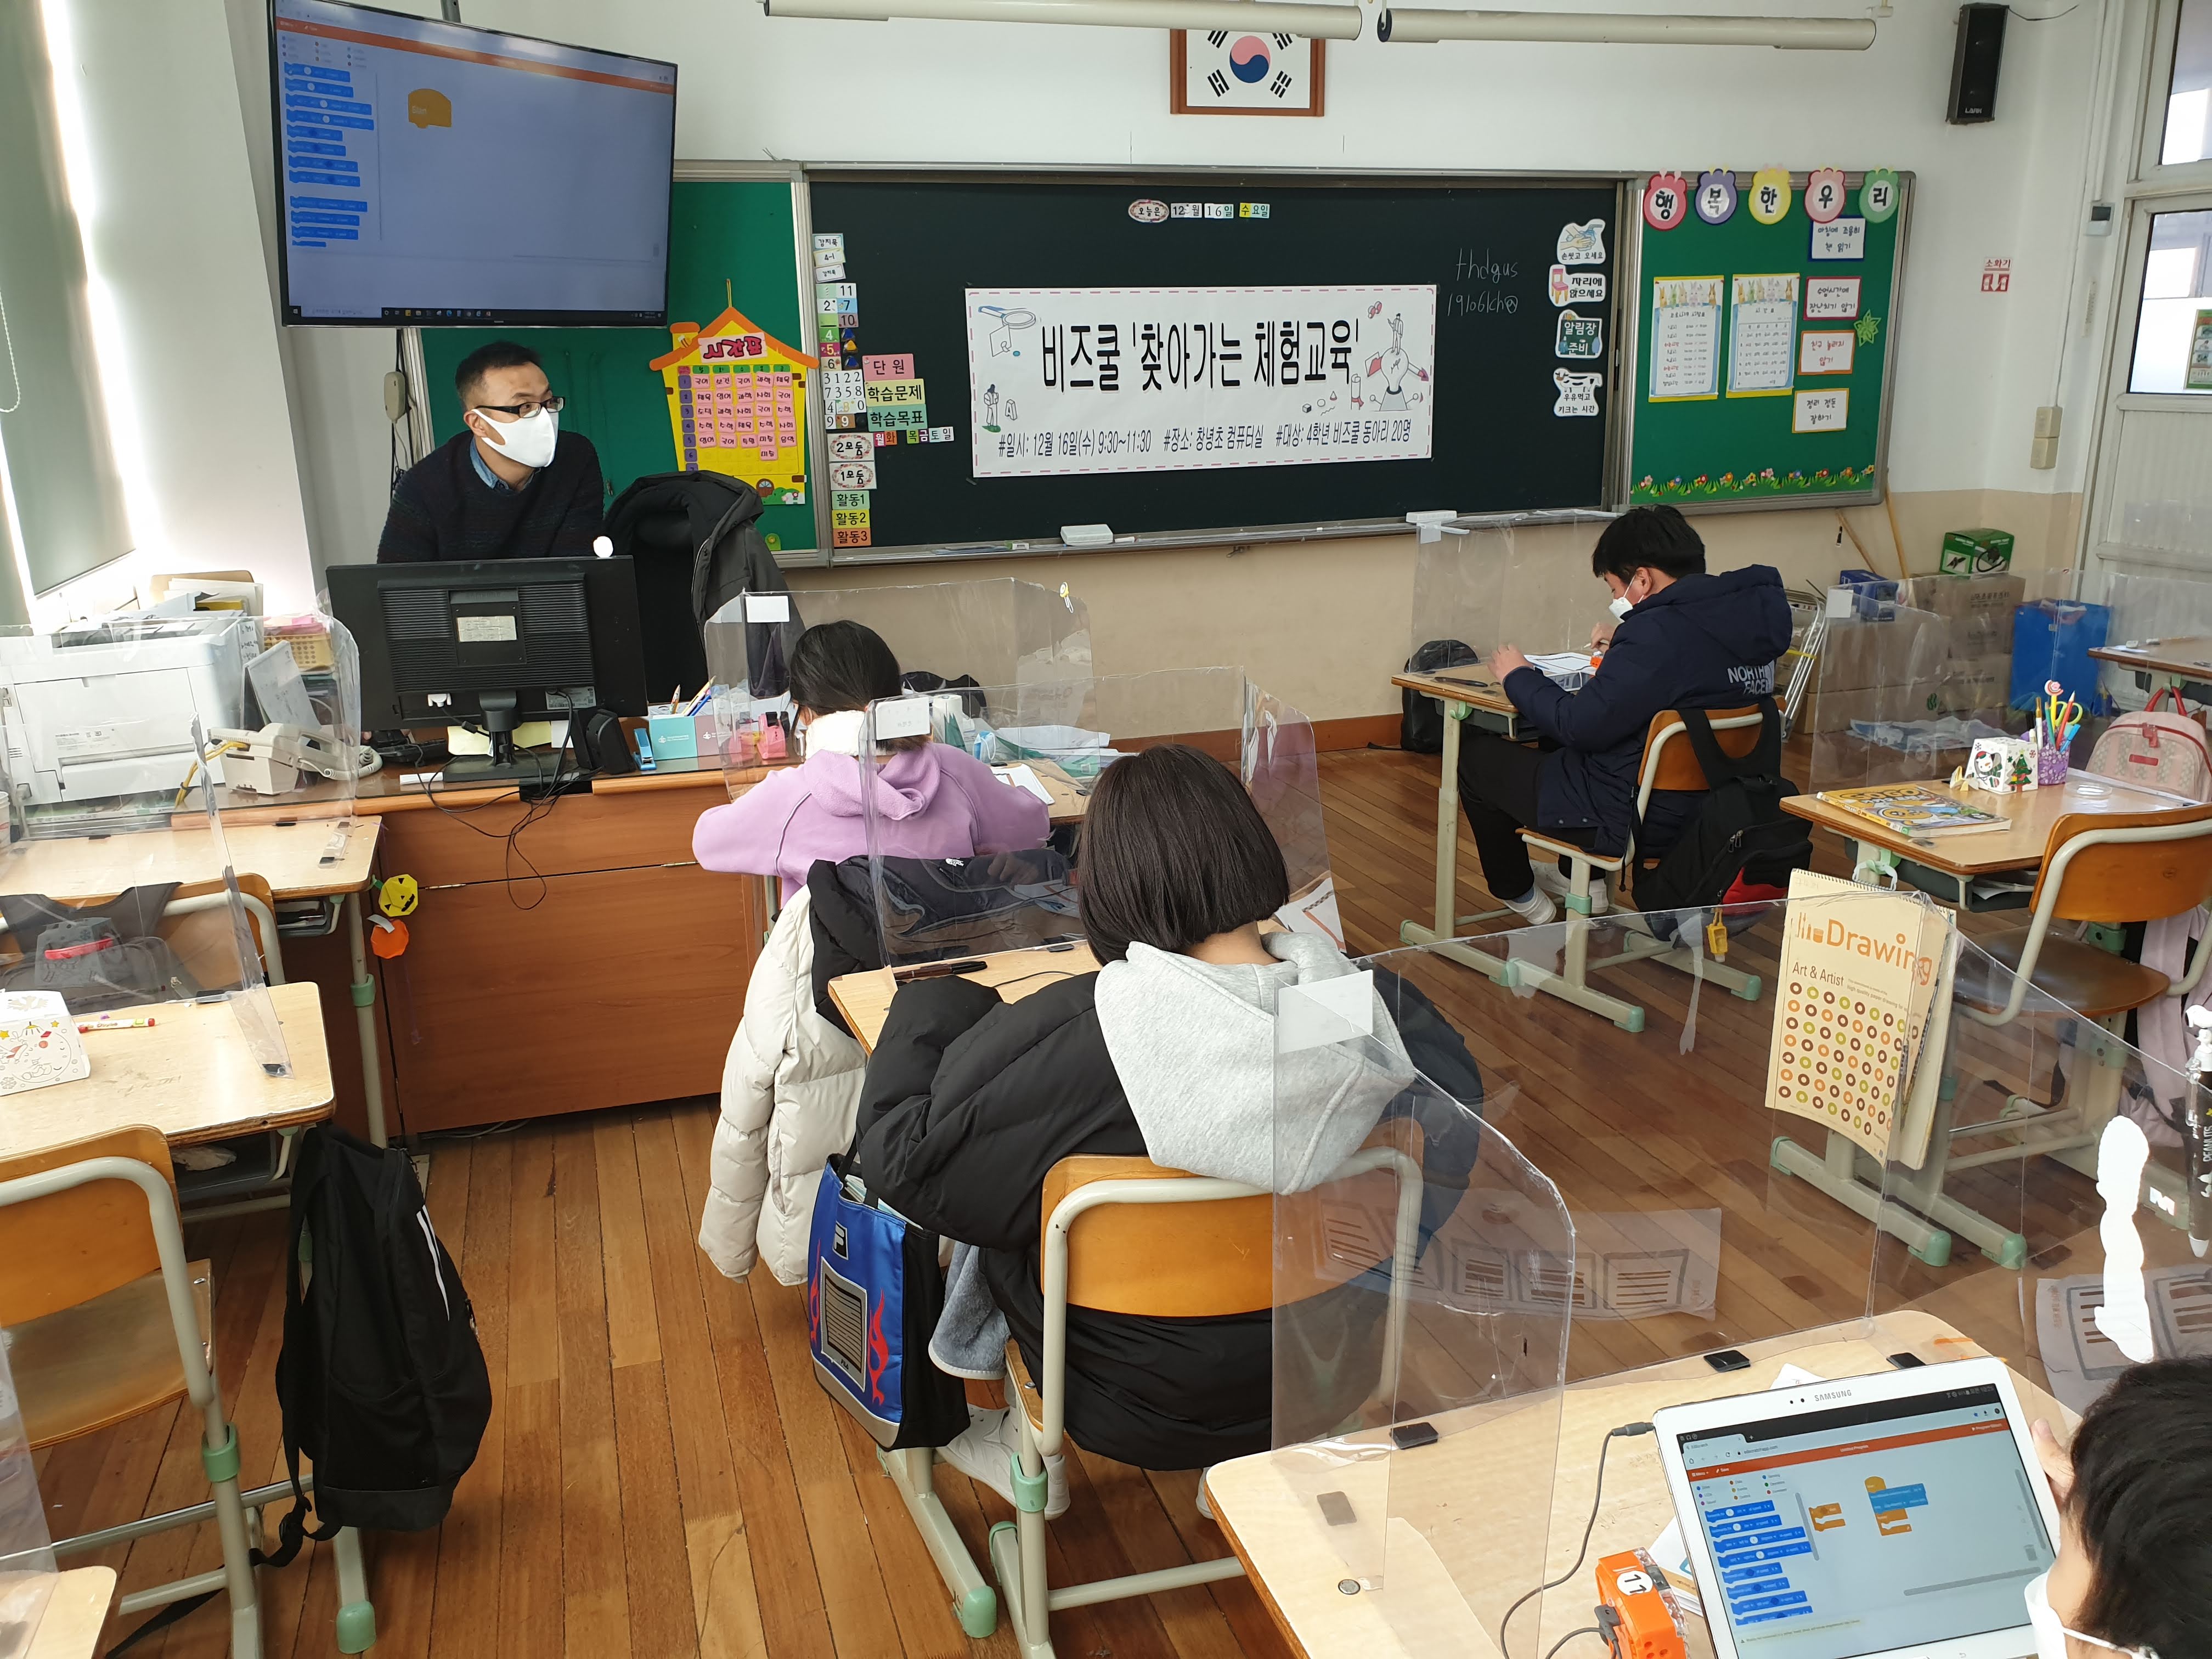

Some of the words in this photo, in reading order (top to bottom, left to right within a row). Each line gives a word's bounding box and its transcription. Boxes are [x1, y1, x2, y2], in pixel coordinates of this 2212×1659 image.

[1138, 206, 1160, 217] 오늘은
[1241, 205, 1268, 217] 수요일
[1818, 226, 1838, 236] 아침에
[1843, 225, 1860, 236] 조용히
[1456, 248, 1518, 283] thdgus
[1985, 259, 2011, 268] 소화기
[1572, 278, 1602, 286] 자리에
[840, 285, 852, 296] 11
[824, 300, 831, 311] 2
[843, 300, 850, 311] 7
[842, 315, 855, 325] 10
[826, 330, 832, 340] 4
[1564, 322, 1596, 336] 알림장
[826, 344, 834, 355] 5
[1568, 342, 1588, 356] 준비
[828, 359, 835, 369] 6
[1042, 324, 1120, 393] 비즈쿨
[867, 385, 922, 403] 학습문제
[1807, 399, 1819, 409] 정리
[827, 416, 834, 427] 9
[841, 416, 849, 427] 9
[870, 411, 924, 428] 학습목표
[998, 433, 1029, 458] #일시:
[1034, 432, 1053, 456] 12월
[1058, 429, 1095, 457] 16일(수)
[1098, 430, 1152, 454] 9:30~11:30
[1164, 427, 1192, 452] #장소:
[1196, 427, 1223, 451] 창녕초
[1227, 425, 1263, 449] 컴퓨터실
[1276, 423, 1304, 447] #대상:
[1307, 422, 1330, 445] 4학년
[1333, 421, 1360, 444] 비즈쿨
[1363, 419, 1389, 444] 동아리
[1391, 419, 1411, 442] 20명
[837, 442, 863, 455] 2모둠
[841, 470, 864, 484] 1모둠
[837, 494, 865, 506] 활동1
[836, 512, 866, 526] 활동2
[837, 531, 867, 543] 활동3
[1727, 665, 1765, 684] NORTH
[1743, 679, 1765, 695] FACE
[1839, 788, 1921, 800] GOGO
[1827, 918, 1932, 986] Drawing
[1792, 962, 1808, 977] Art
[1810, 966, 1817, 979] &
[1820, 969, 1844, 986] Artist
[1814, 1390, 1852, 1402] SAMSUNG
[1624, 1574, 1646, 1593] 11
